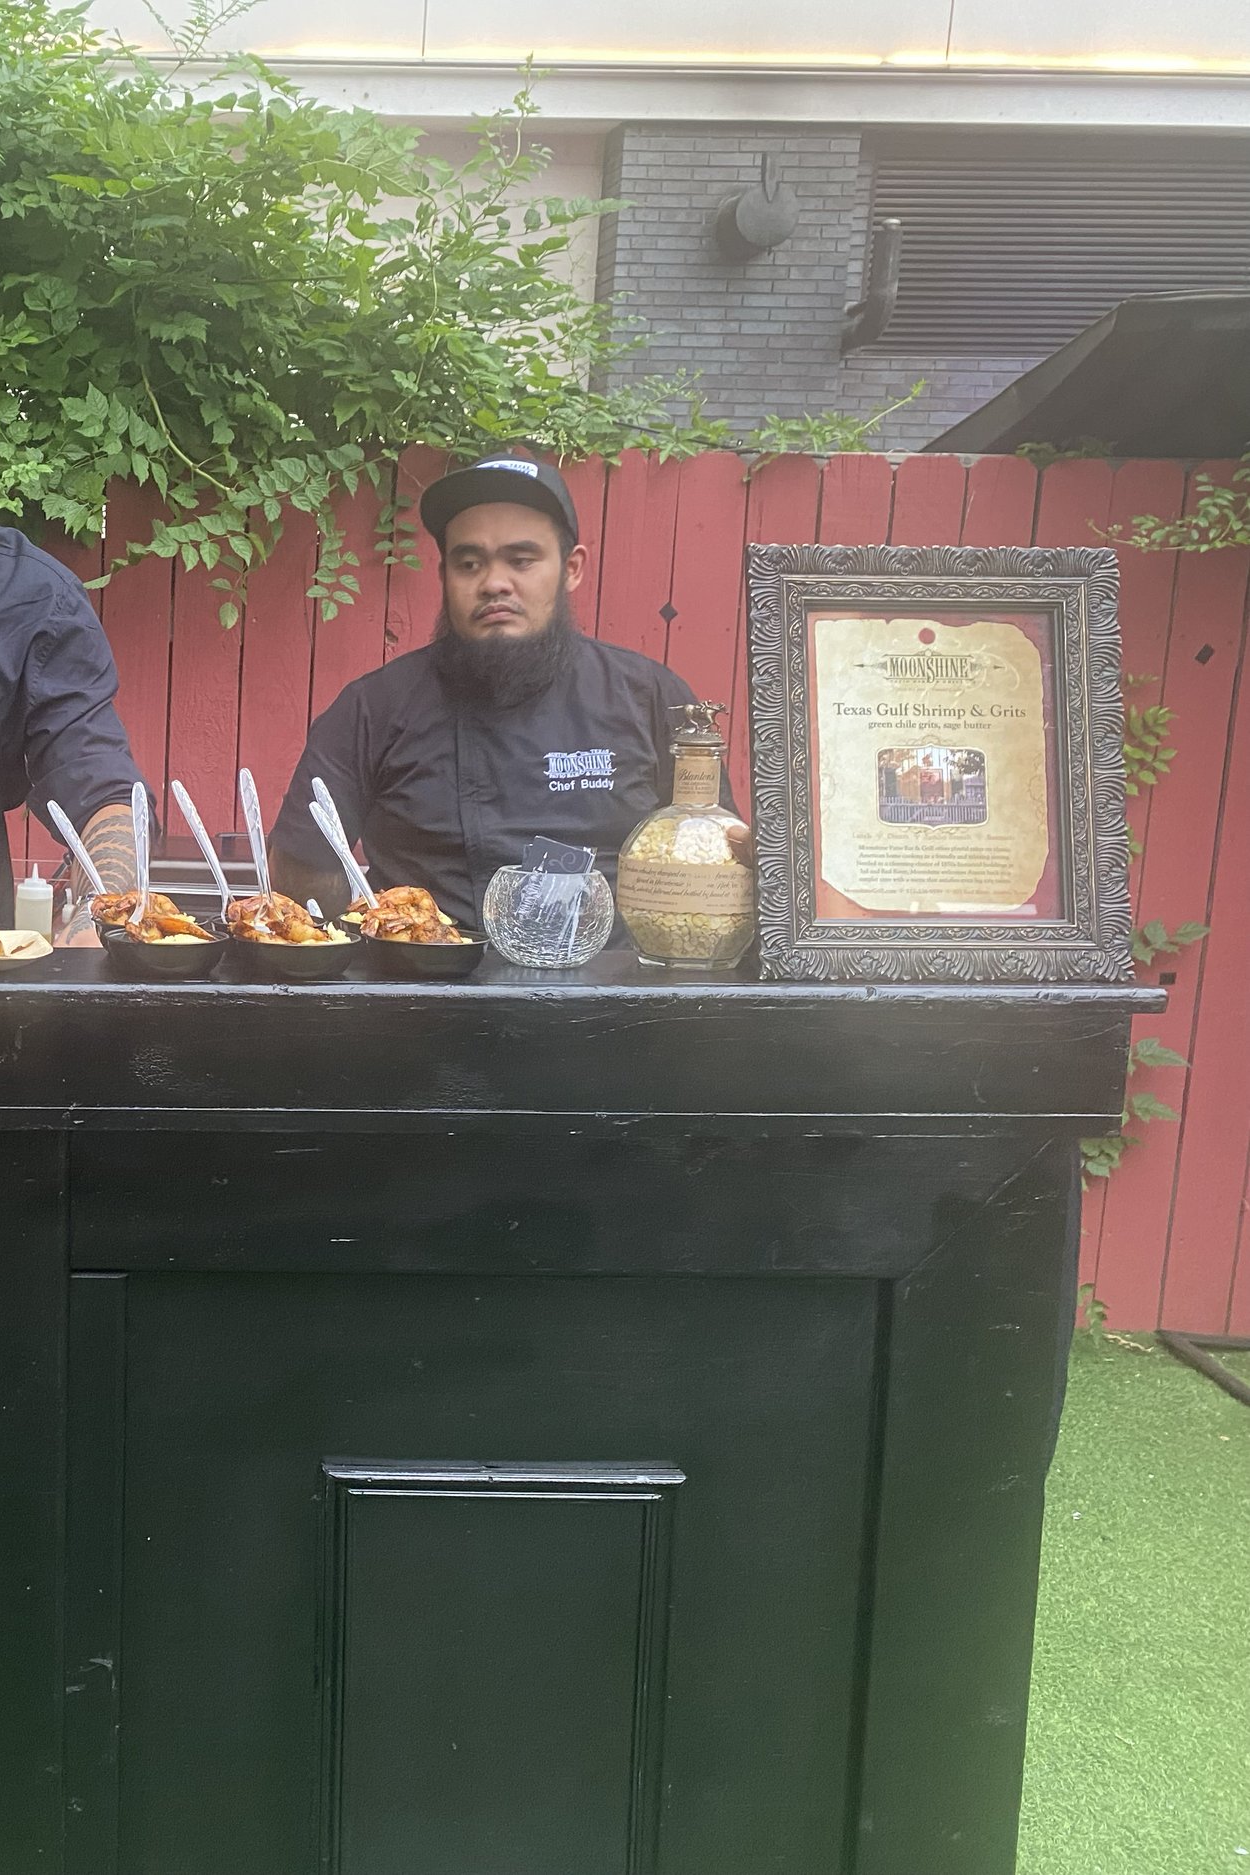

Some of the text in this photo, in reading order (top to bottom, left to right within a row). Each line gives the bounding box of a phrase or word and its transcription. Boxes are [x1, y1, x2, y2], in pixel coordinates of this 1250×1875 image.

[889, 657, 968, 683] MOONSHINE
[833, 702, 1026, 720] Texas Gulf Shrimp & Grits
[868, 720, 992, 731] green chile grits, sage butter
[549, 755, 612, 776] MOONSHINE
[548, 778, 614, 791] Chef Buddy
